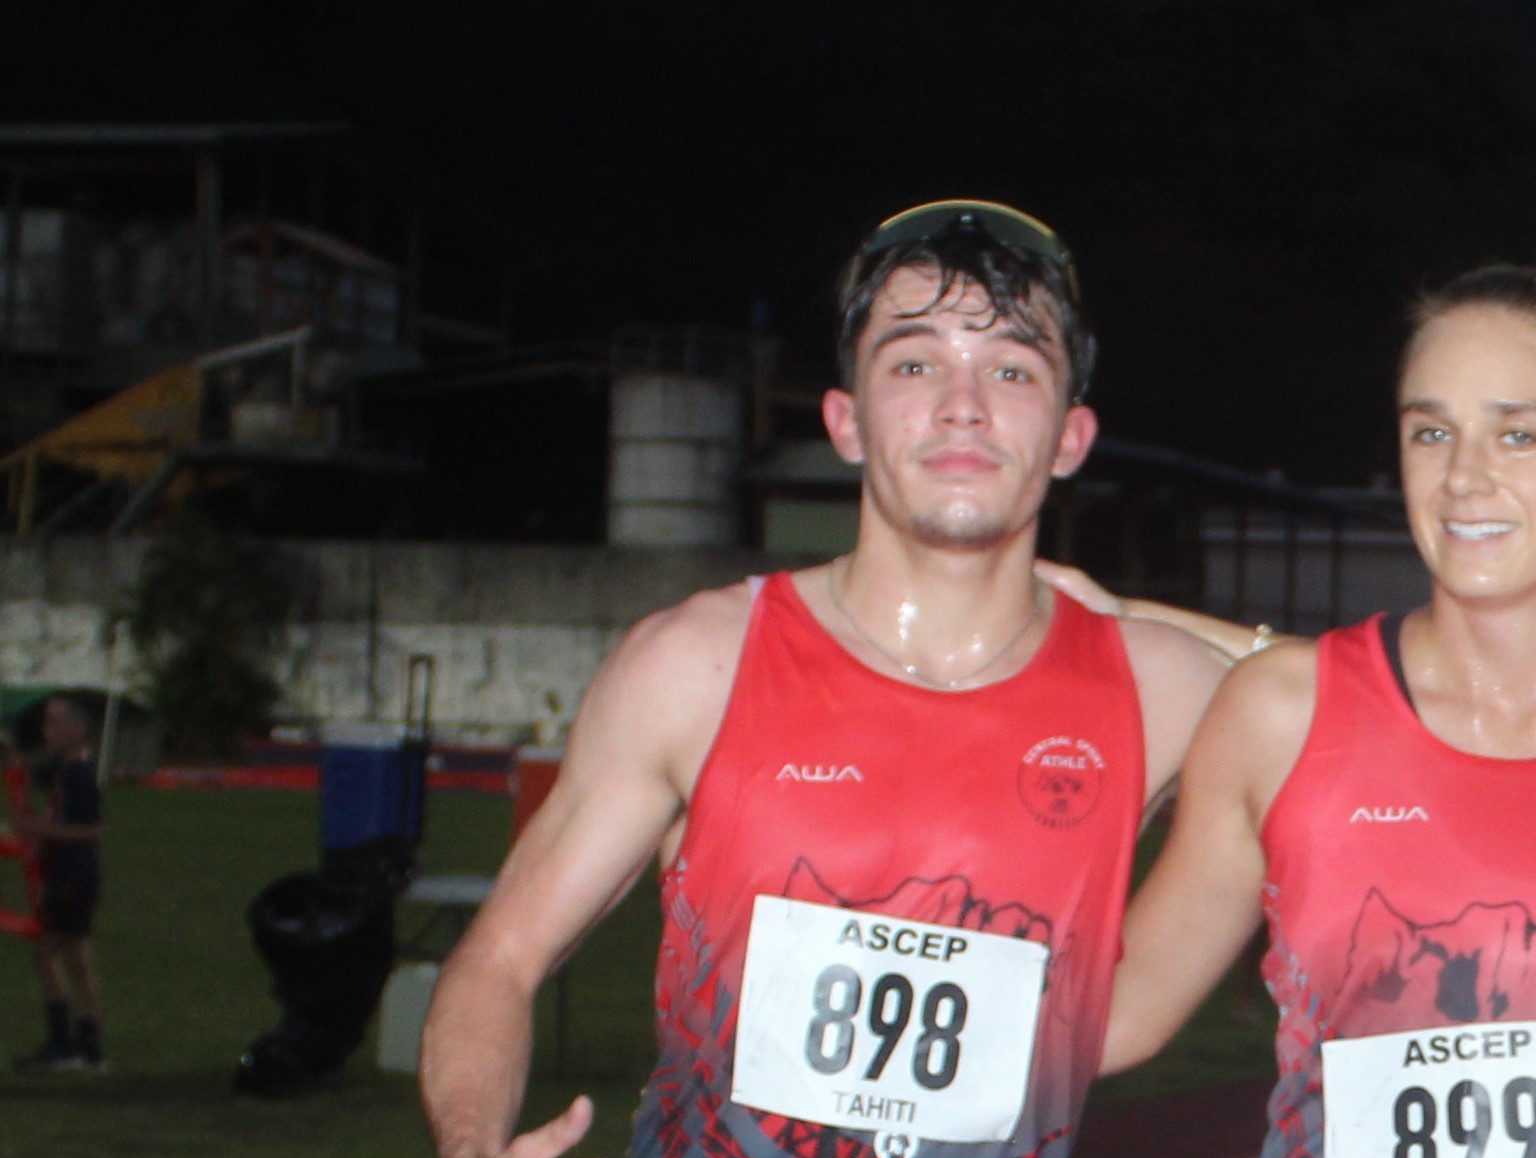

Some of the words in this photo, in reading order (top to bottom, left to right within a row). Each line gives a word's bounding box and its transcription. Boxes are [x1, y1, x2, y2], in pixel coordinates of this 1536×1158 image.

[1023, 736, 1072, 764] CENTRAL
[1040, 754, 1087, 770] ATHLE
[837, 918, 968, 962] ASCEP
[803, 963, 968, 1091] 898
[1402, 1029, 1532, 1067] ASCEP
[832, 1090, 916, 1124] TAHITI
